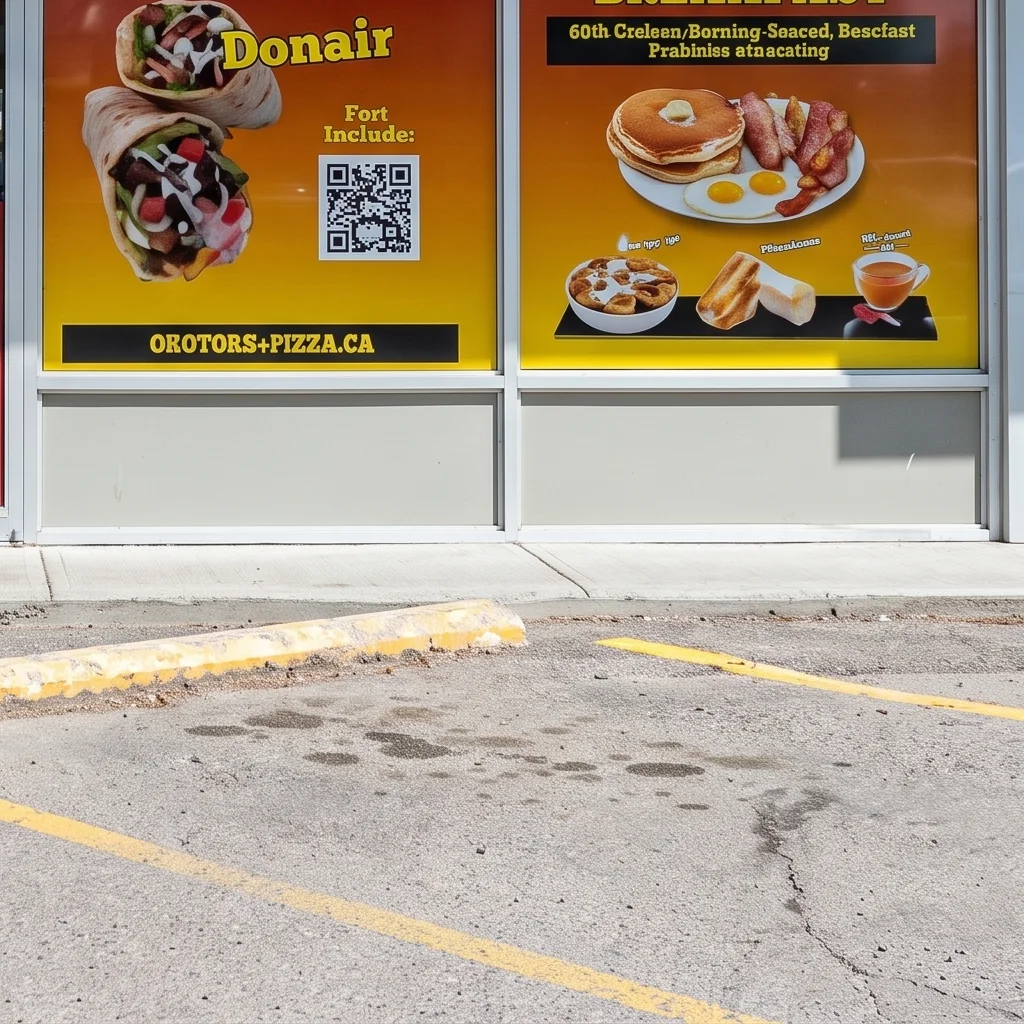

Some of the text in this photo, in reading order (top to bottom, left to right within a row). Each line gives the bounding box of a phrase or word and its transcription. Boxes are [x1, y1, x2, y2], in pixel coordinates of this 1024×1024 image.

[220, 17, 393, 69] Donair
[345, 105, 388, 122] Fort
[323, 124, 416, 144] Include:
[150, 333, 375, 354] OROTORS+PIZZA.CA
